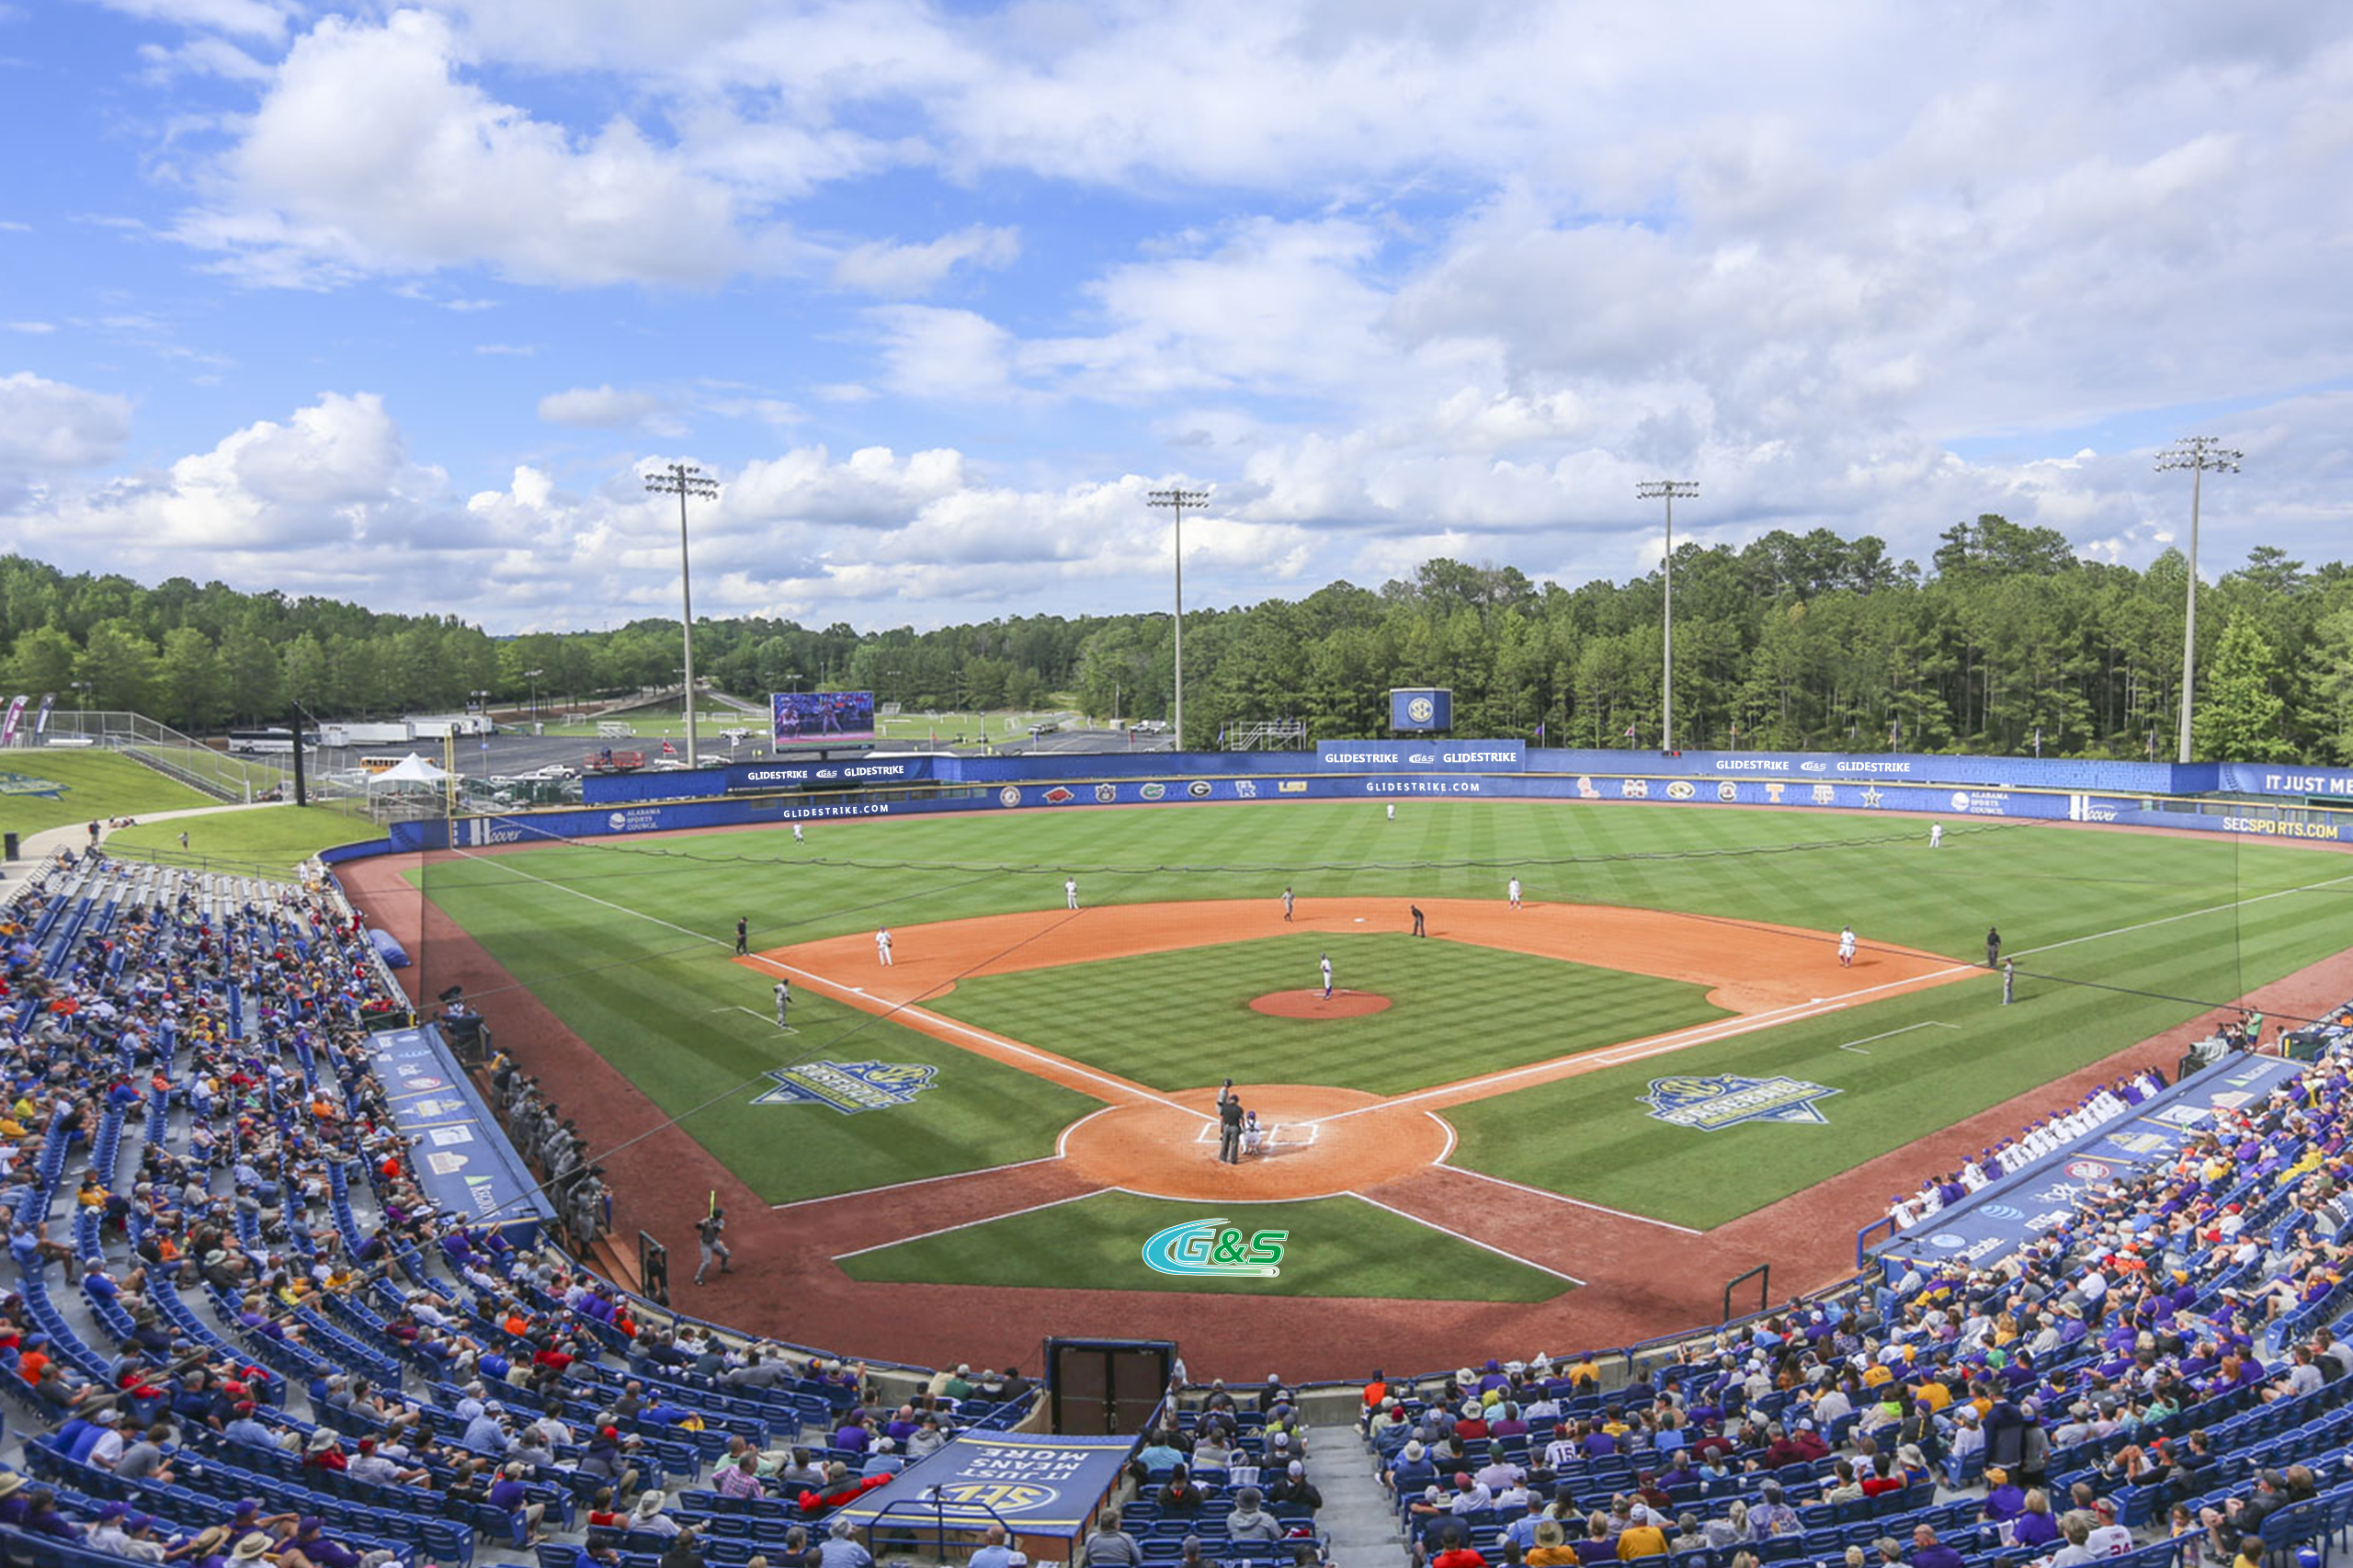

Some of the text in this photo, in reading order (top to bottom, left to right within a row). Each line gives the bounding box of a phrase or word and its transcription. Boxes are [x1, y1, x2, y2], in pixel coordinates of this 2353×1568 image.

[1324, 752, 1517, 764] GLIDESTRIKE G&S GLIDESTRIKE
[1716, 760, 1911, 772] GLIDESTRIKE G&S GLIDESTRIKE
[747, 765, 904, 780] GLIDESTRIKE G&S GLIDESTRIKE
[1367, 782, 1480, 792] GLIDESTRIKE.COM
[2266, 774, 2281, 790] IT
[2283, 776, 2325, 792] JUST
[1971, 791, 2008, 801] ALABAMA
[1971, 799, 1999, 808] SPORTS
[627, 808, 661, 816] ALABAMA
[783, 804, 889, 818] GLIDESTRIKE.COM
[1970, 805, 2005, 815] COUNCIL
[2222, 816, 2338, 839] SECSPORTS.COM
[976, 1447, 1090, 1461] MORE.
[970, 1458, 1082, 1471] MEANS
[956, 1468, 1073, 1481] IT JUST
